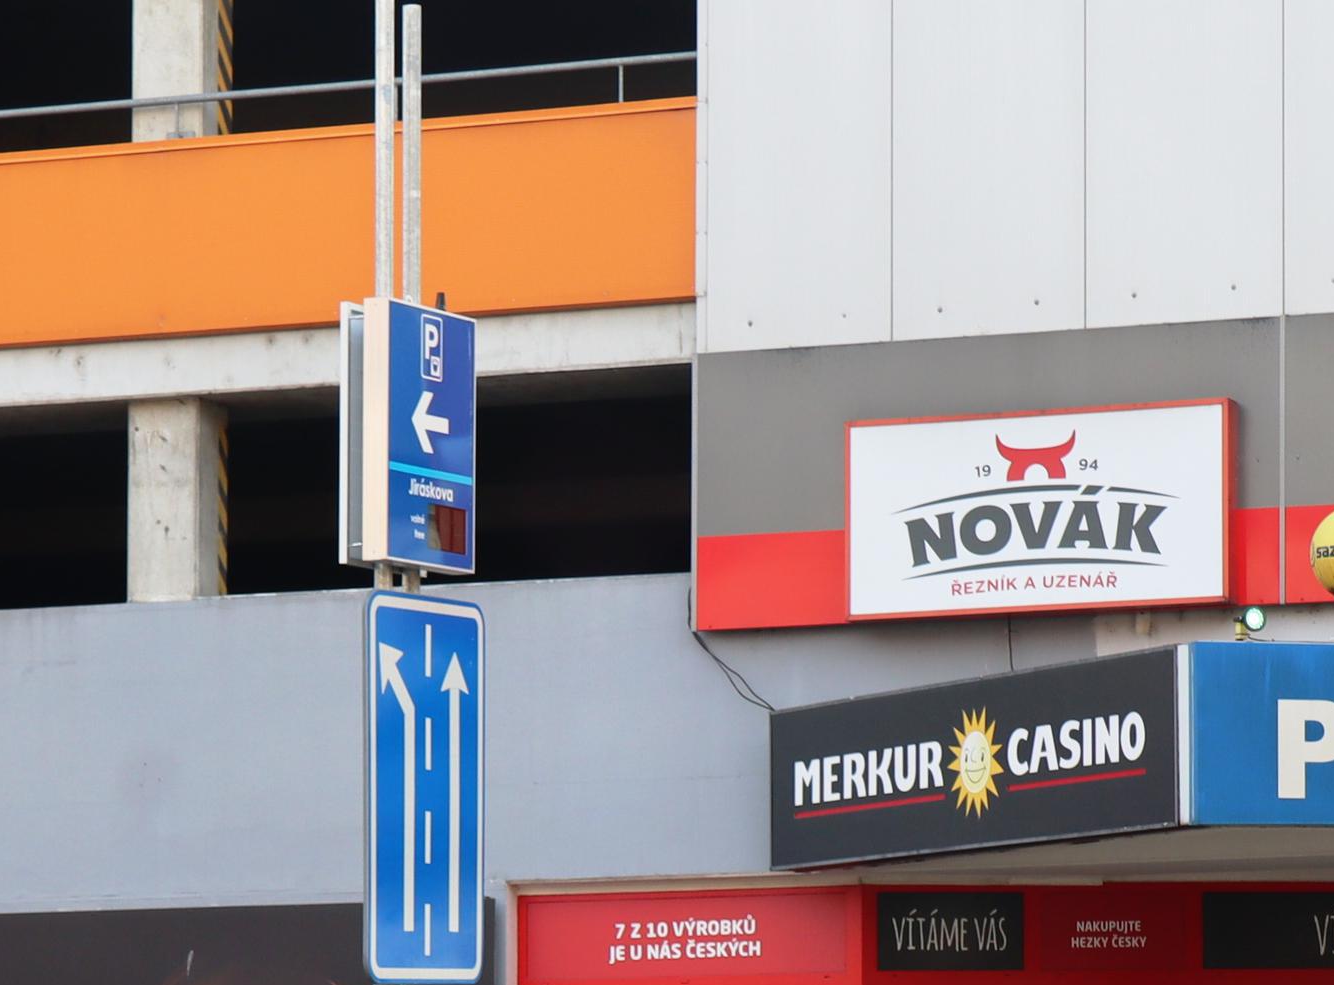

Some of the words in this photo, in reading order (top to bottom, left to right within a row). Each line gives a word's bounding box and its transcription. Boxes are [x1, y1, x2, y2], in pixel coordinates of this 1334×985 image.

[975, 465, 991, 477] 19
[1079, 459, 1098, 470] 94
[408, 478, 454, 502] Jiráskova
[904, 485, 1167, 567] NOVÁK
[951, 574, 1017, 596] ŘEZNÍK
[1024, 576, 1036, 589] A
[1042, 571, 1118, 588] UZENÁŘ
[794, 741, 944, 807] MERKUR
[1007, 711, 1146, 777] CASINO
[615, 924, 625, 939] 7
[631, 923, 641, 938] Z
[647, 922, 668, 938] 10
[672, 914, 756, 937] VÝROBKŮ
[892, 908, 968, 952] VÍTÁME
[974, 909, 1007, 951] VÁS
[1076, 920, 1141, 934] NAKUPUJTE
[609, 946, 625, 964] JE
[630, 945, 642, 960] U
[647, 940, 681, 960] NÁS
[686, 938, 761, 958] ČESKÝCH
[1071, 937, 1108, 949] HEZKY
[1112, 934, 1147, 949] ČESKY
